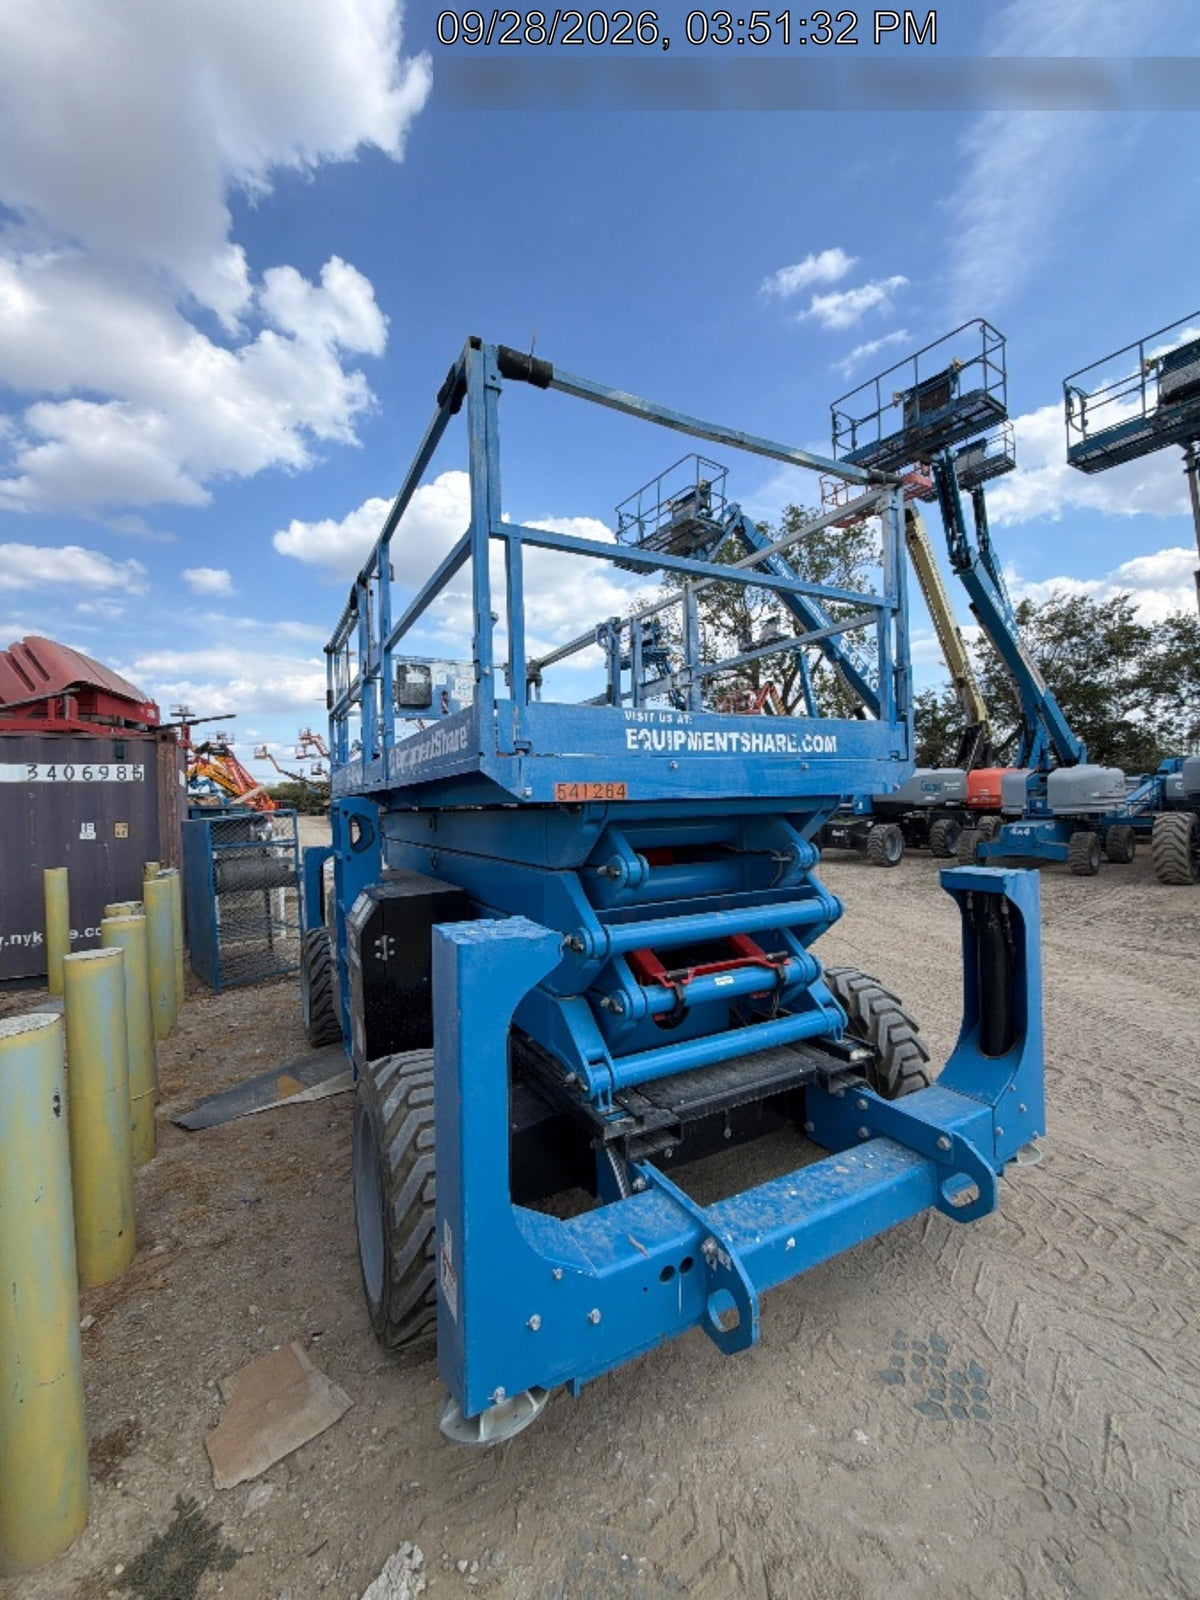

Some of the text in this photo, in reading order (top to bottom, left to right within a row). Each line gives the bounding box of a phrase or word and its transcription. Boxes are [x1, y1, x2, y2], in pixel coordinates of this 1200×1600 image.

[624, 710, 655, 723] VISIT
[659, 713, 673, 723] US
[625, 727, 838, 753] EQUIPMENTSHARE.COM
[557, 783, 626, 801] 541264
